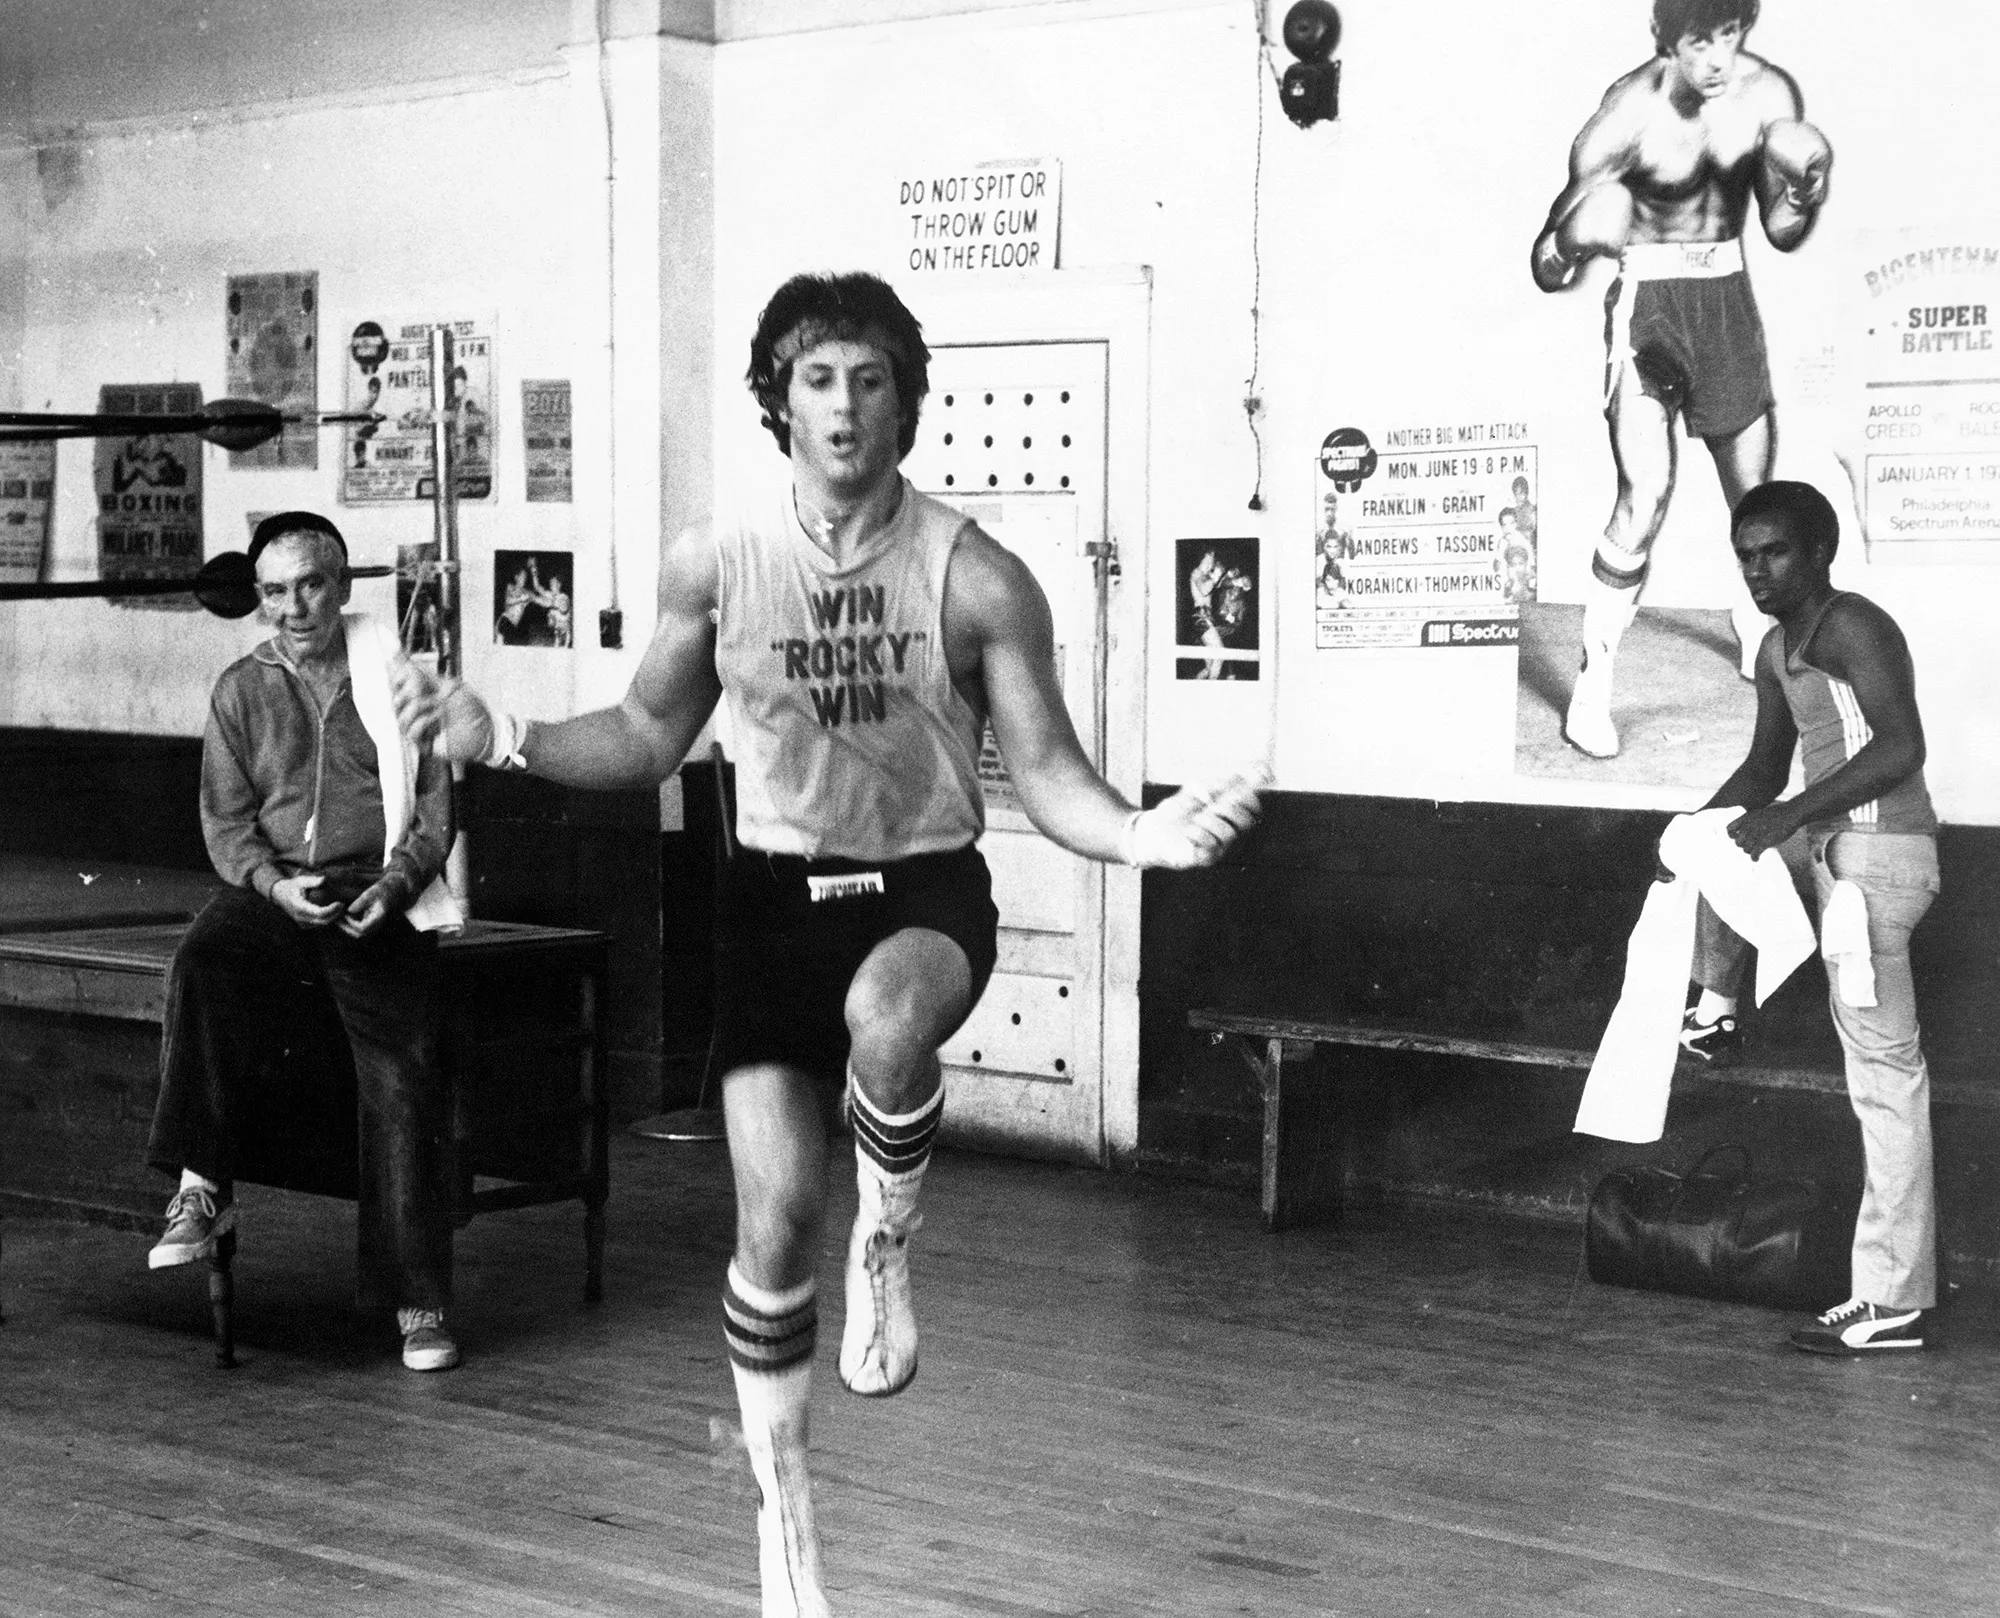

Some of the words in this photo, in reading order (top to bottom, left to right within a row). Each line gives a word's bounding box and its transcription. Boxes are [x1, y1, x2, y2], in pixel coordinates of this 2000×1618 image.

[900, 181, 925, 205] DO
[932, 177, 968, 202] NOT
[974, 174, 1015, 201] SPIT
[1021, 171, 1046, 198] OR
[911, 211, 986, 239] THROW
[994, 209, 1038, 236] GUM
[910, 248, 937, 270] ON
[943, 246, 976, 270] THE
[981, 242, 1040, 268] FLOOR
[1908, 304, 1987, 329] SUPER
[1901, 329, 1993, 353] BATTLE
[1868, 404, 1922, 418] APOLLO
[1387, 428, 1432, 447] ANOTHER
[1436, 427, 1453, 445] BIG
[1458, 424, 1484, 443] MATT
[1489, 422, 1528, 441] ATTACK
[1865, 422, 1922, 440] CREED
[1425, 459, 1457, 478] JUNE
[1462, 457, 1477, 475] 19
[1486, 456, 1494, 474] 8
[1500, 455, 1528, 474] P.M.
[1877, 466, 1959, 483] JANUARY
[101, 493, 200, 512] BOXING
[1362, 498, 1426, 517] FRANKLIN
[1442, 495, 1485, 514] GRANT
[1902, 497, 1990, 512] Philadelphia
[1889, 515, 1959, 531] Spectrum
[1355, 537, 1418, 556] ANDREWS
[1436, 534, 1495, 553] TASSONE
[812, 584, 884, 629] WIN
[809, 680, 886, 728] WIN
